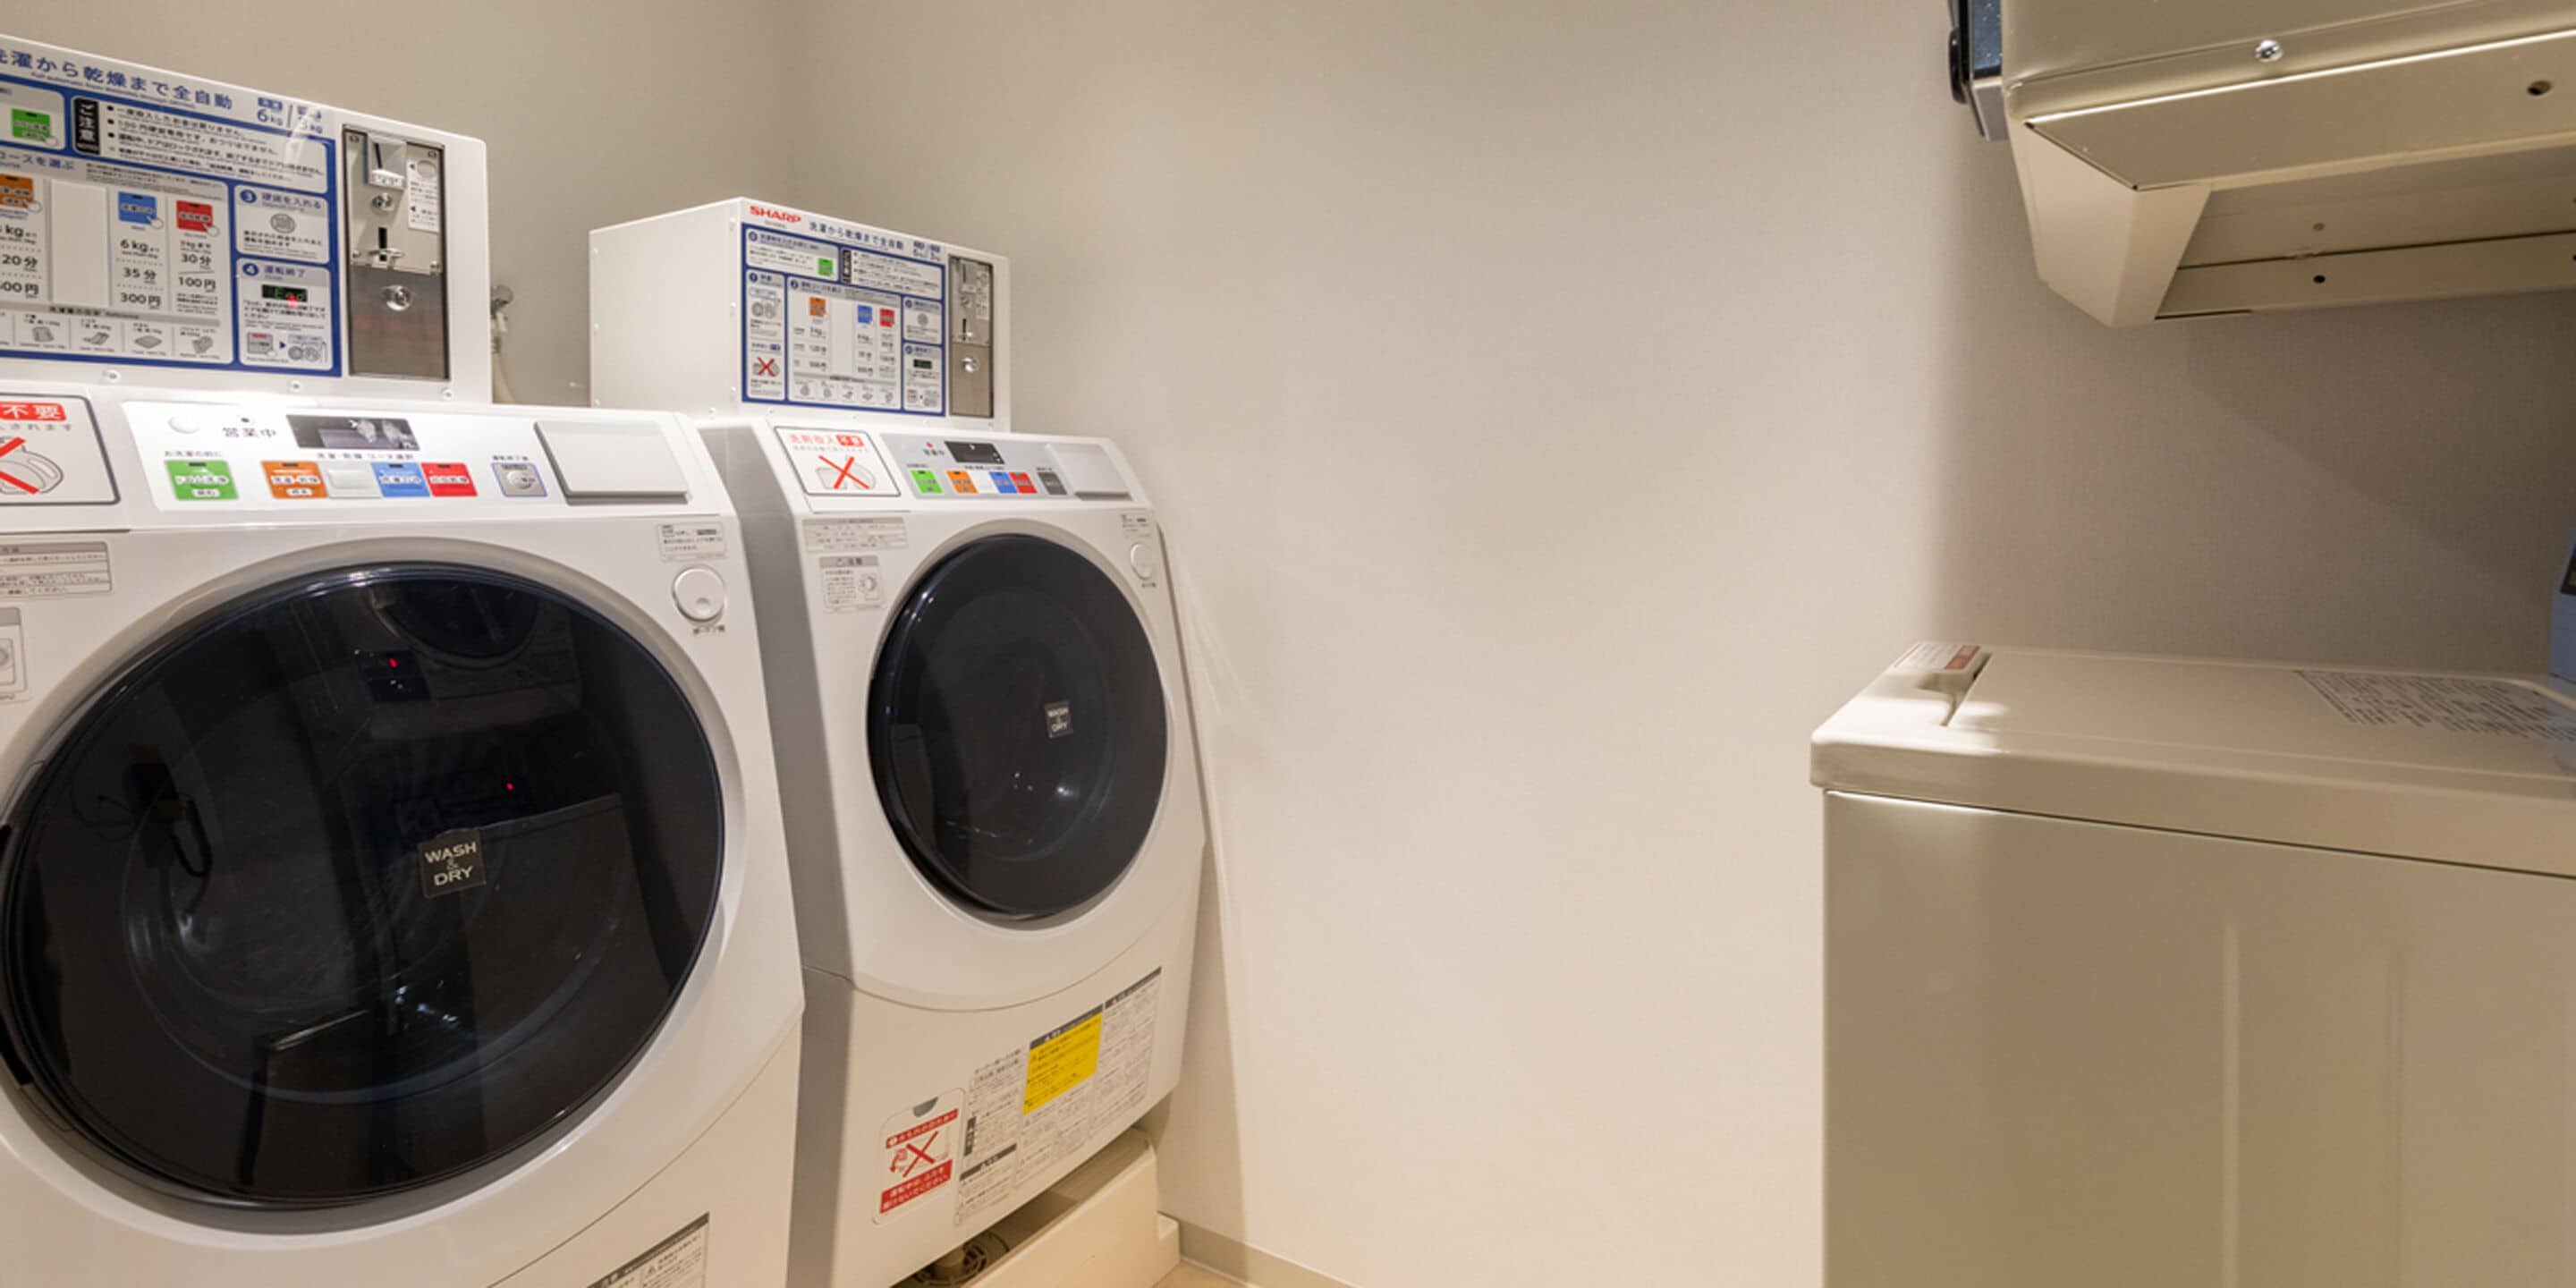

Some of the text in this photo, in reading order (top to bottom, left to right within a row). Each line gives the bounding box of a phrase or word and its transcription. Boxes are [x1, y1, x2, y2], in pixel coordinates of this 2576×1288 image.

[749, 205, 801, 223] SHARP
[0, 282, 39, 295] 00円
[1047, 708, 1069, 717] WASH
[424, 842, 477, 863] WASH
[434, 865, 473, 886] DRY
